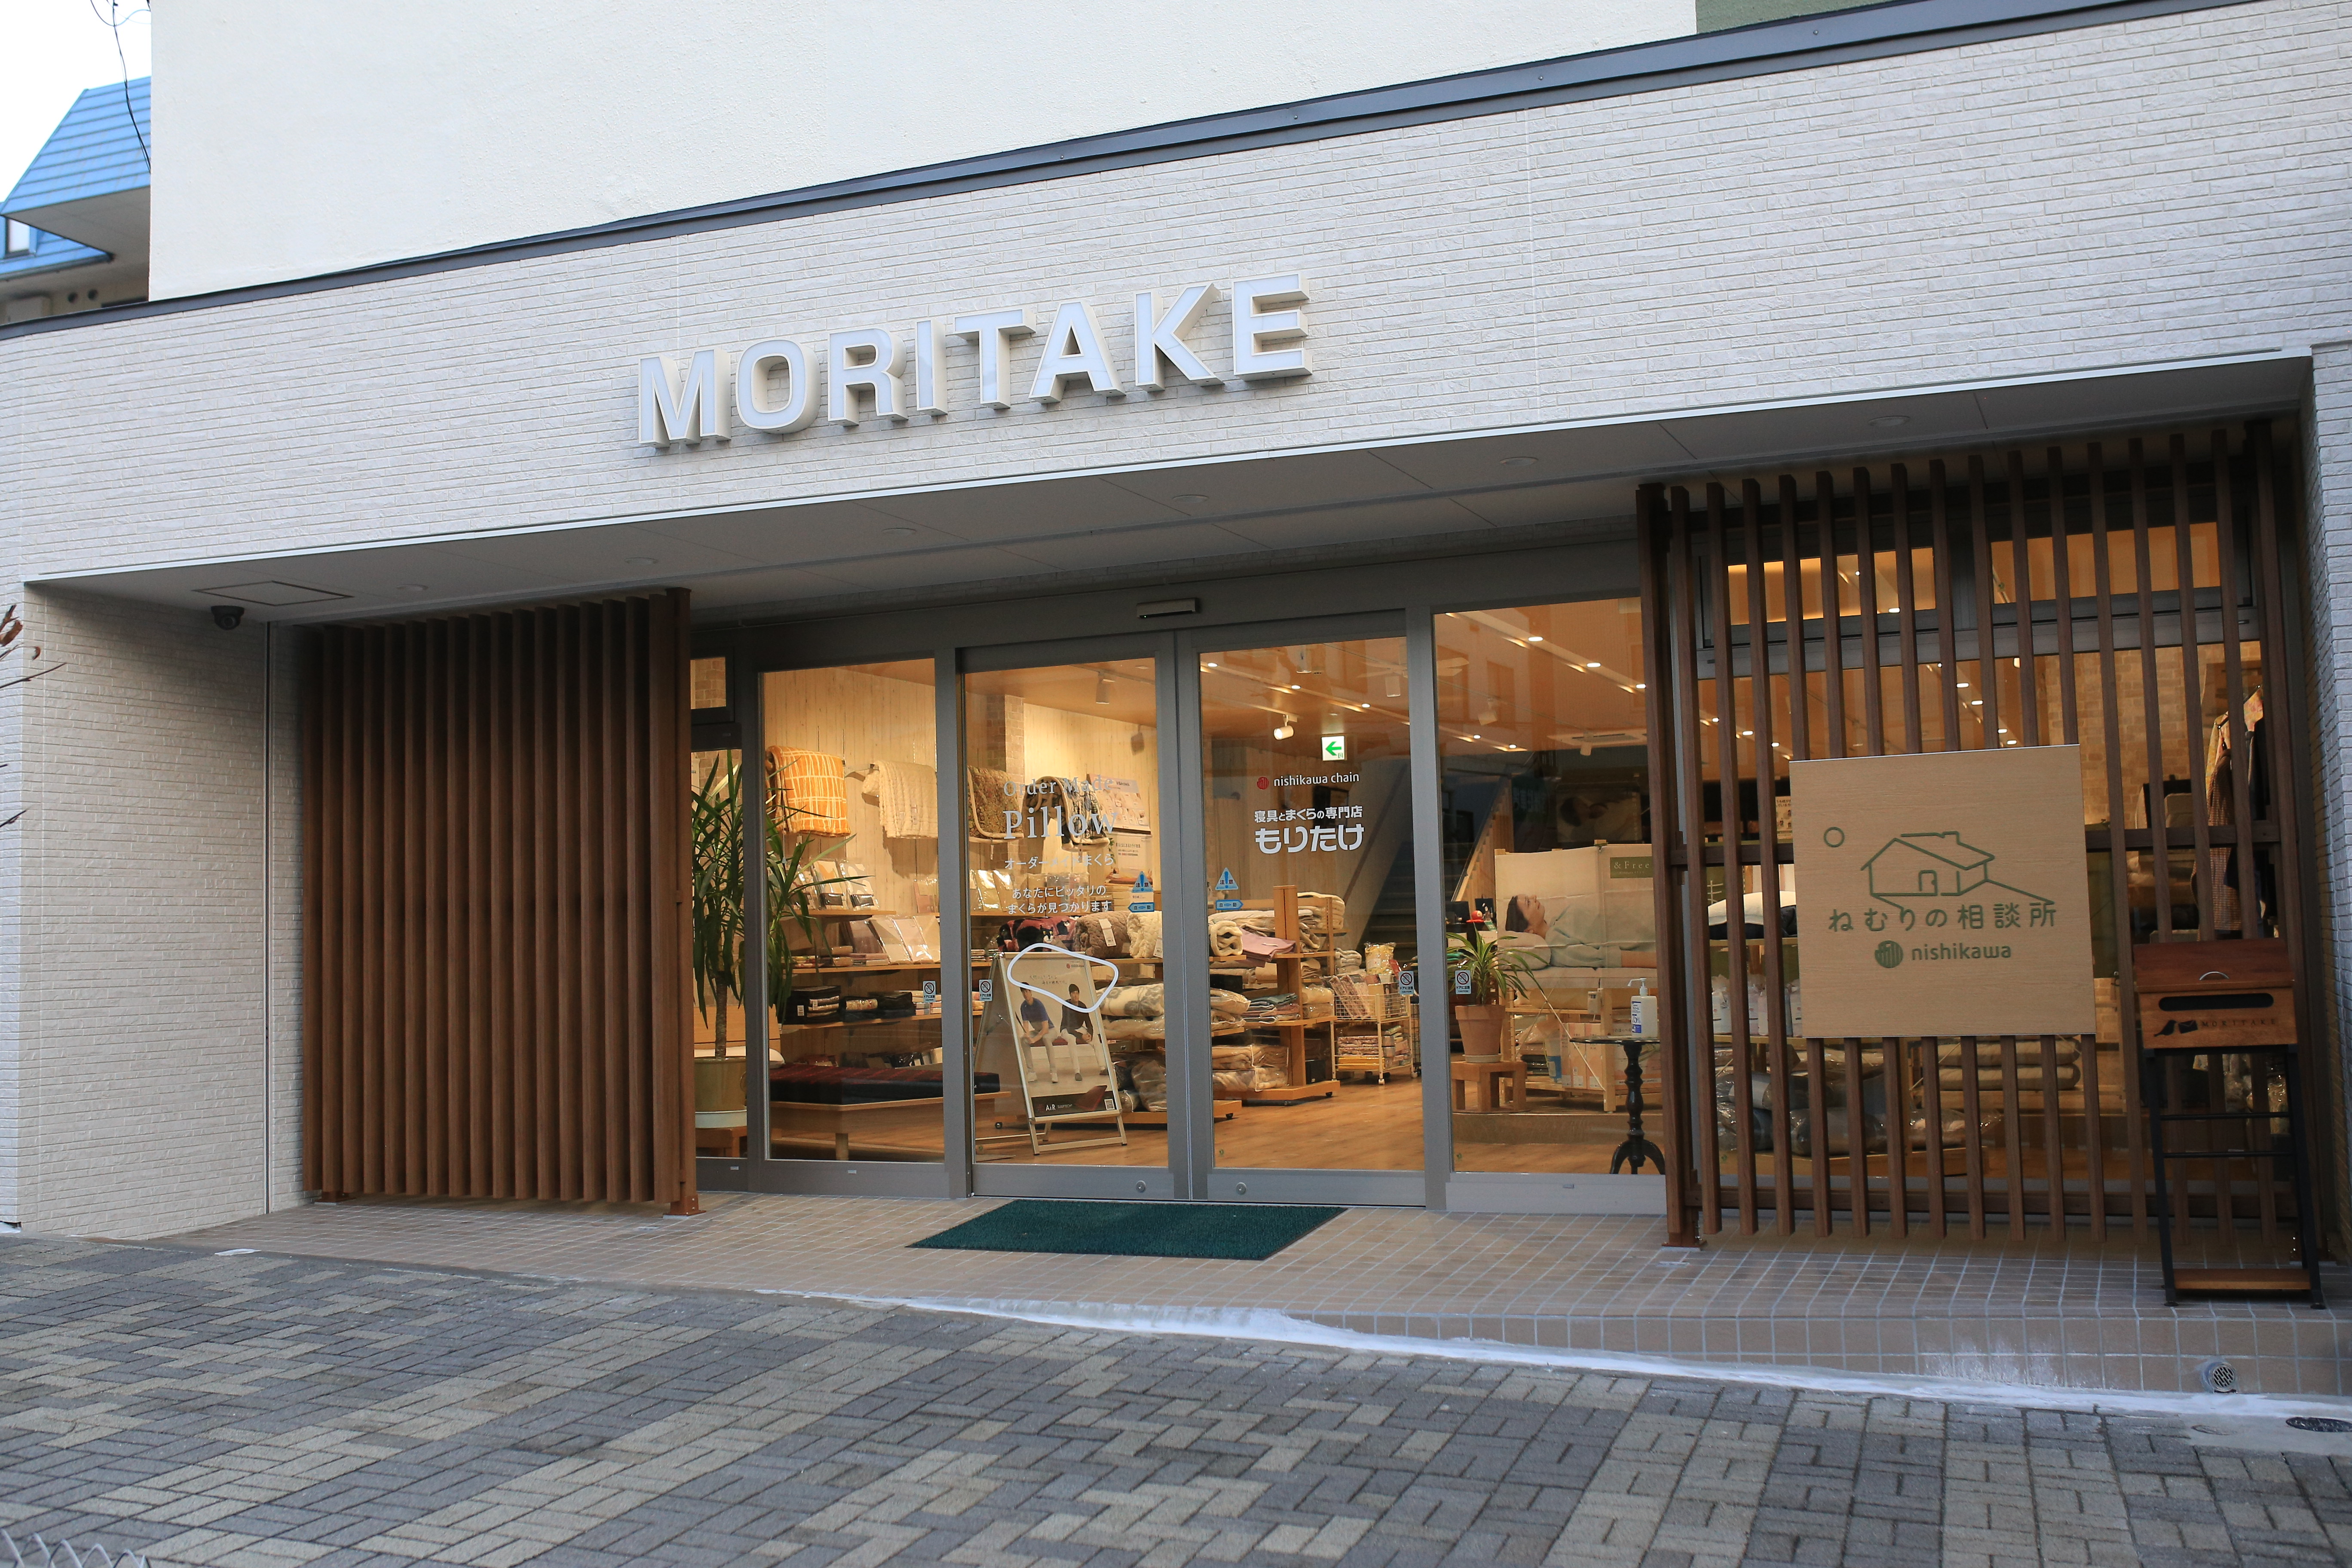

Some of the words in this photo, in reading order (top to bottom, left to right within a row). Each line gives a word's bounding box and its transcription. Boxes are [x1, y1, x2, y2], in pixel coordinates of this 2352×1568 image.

[638, 271, 1313, 448] MORITAKE
[1004, 778, 1057, 797] Order
[1062, 774, 1114, 793] Made
[1274, 775, 1328, 787] nishikawa
[1331, 772, 1360, 784] chain
[1003, 805, 1118, 840] Pillow
[1254, 805, 1363, 824] 寝具とまくらの専門店
[1255, 824, 1365, 854] もりたけ
[1004, 853, 1114, 870] オーダーメイドまくら
[1013, 885, 1106, 899] あなたにピッタリの
[1008, 900, 1112, 915] まくらが見つかります
[1828, 902, 2056, 932] ねむりの相談所
[1911, 943, 2012, 961] nishikawa
[2202, 1019, 2276, 1027] MORITAKE
